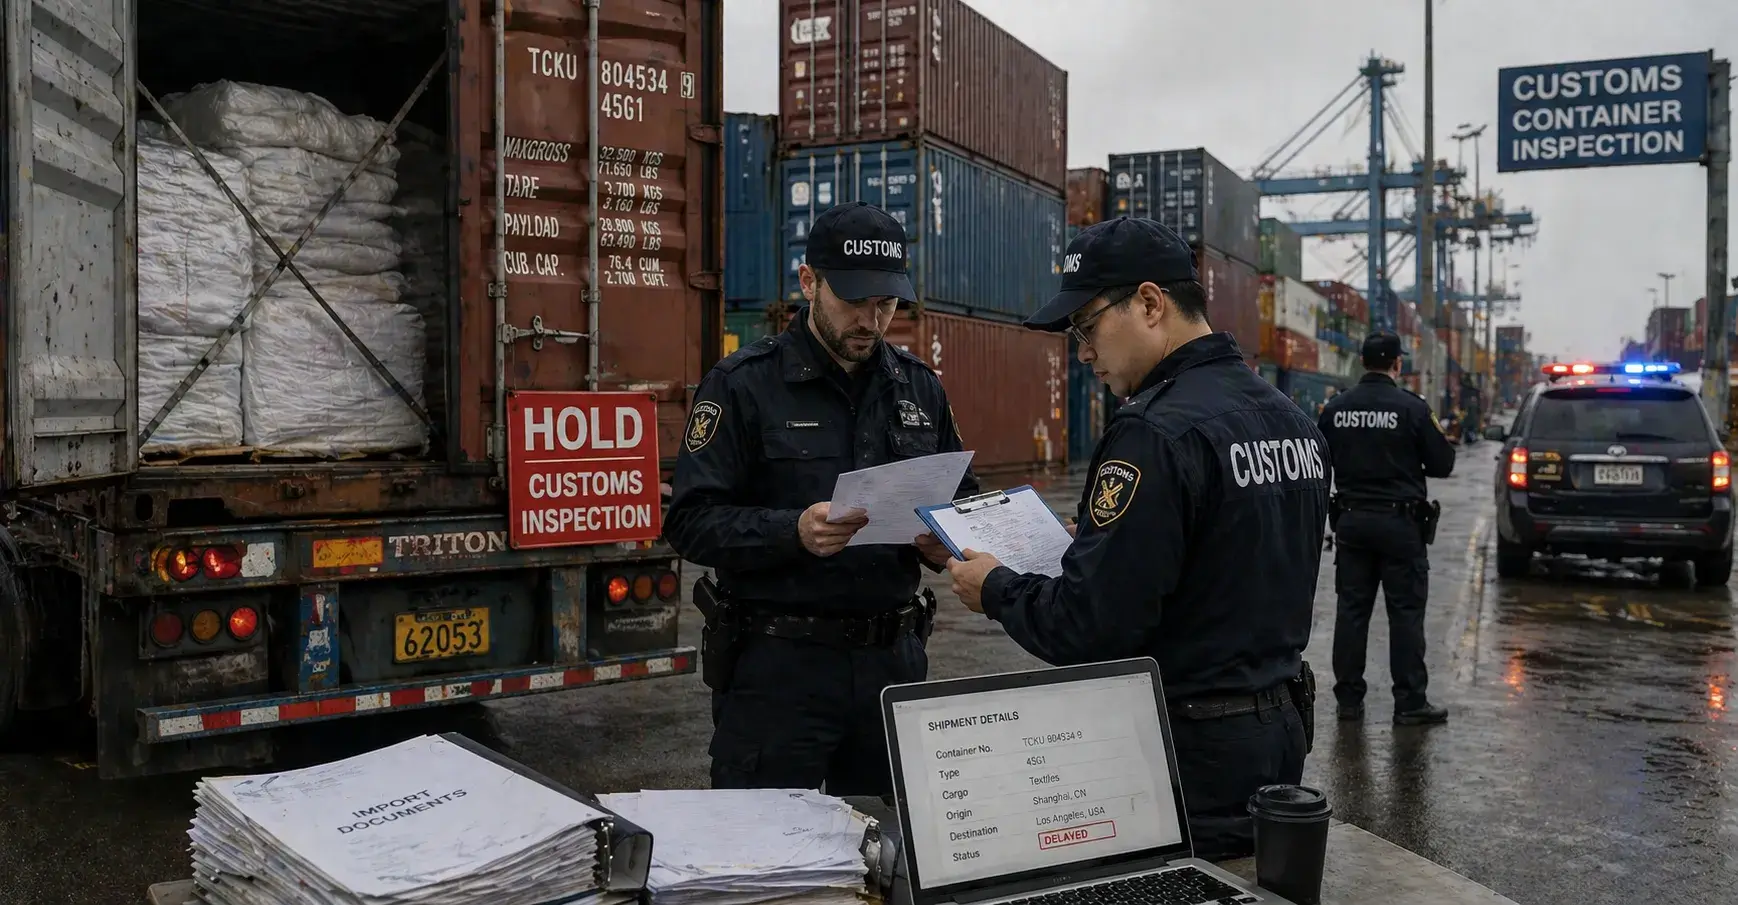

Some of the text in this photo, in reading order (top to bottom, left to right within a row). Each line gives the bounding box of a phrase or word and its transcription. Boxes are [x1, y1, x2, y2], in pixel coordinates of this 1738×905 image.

[528, 47, 693, 97] TCKU 804534 9
[1512, 64, 1683, 101] CUSTOMS
[601, 93, 644, 122] 45G1
[1512, 99, 1682, 132] CONTAINER
[504, 136, 571, 162] MAXGROSS
[1512, 130, 1684, 161] INSPECTION
[598, 161, 658, 179] 71.650 LBS
[505, 174, 540, 198] TARE
[602, 197, 660, 215] 3.160 LBS
[504, 212, 661, 238] PAYLOAD 28.800 KGS
[642, 236, 662, 250] LBS
[843, 240, 902, 259] CUSTOMS
[504, 251, 664, 276] CUB. CAP. 76.4 CUM.
[604, 271, 668, 287] 2.700 CUFT.
[524, 406, 643, 451] HOLD
[1334, 411, 1398, 429] CUSTOMS
[1230, 438, 1324, 488] CUSTOMS
[529, 470, 643, 499] CUSTOMS
[522, 504, 651, 535] INSPECTION
[388, 531, 507, 558] TRITON
[404, 620, 482, 657] 62053
[928, 711, 1019, 731] SHIPMENT DETAILS
[936, 747, 977, 759] Container
[978, 744, 994, 753] No.
[1022, 736, 1044, 747] TCKU
[939, 769, 960, 780] Type
[352, 789, 432, 818] IMPORT
[942, 789, 969, 800] Cargo
[946, 809, 973, 820] Origin
[1074, 789, 1087, 799] CN
[337, 789, 468, 834] DOCUMENTS
[949, 806, 1106, 841] Destination Los Angeles, USA
[953, 829, 1088, 862] Status DELAYED
